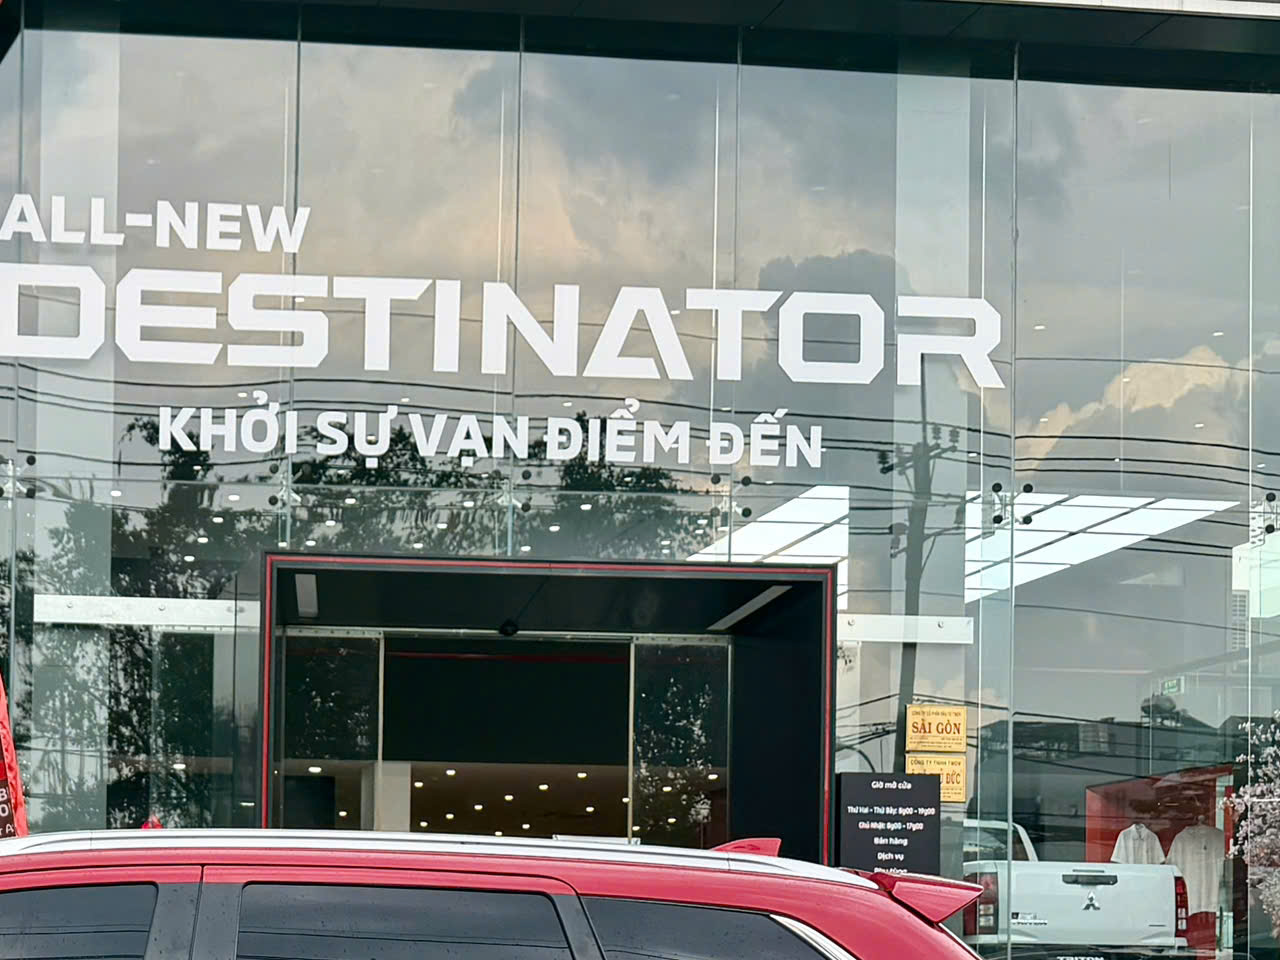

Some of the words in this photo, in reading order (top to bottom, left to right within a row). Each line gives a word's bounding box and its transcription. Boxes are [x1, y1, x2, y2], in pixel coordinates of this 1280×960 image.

[158, 390, 298, 455] KHỞI
[316, 405, 398, 468] SỰ
[408, 412, 528, 467] VẠN
[543, 397, 691, 464] ĐIỂM
[706, 408, 822, 468] ĐẾN
[911, 718, 932, 734] SÀI
[935, 719, 961, 735] GÒN
[877, 852, 894, 861] Dịch
